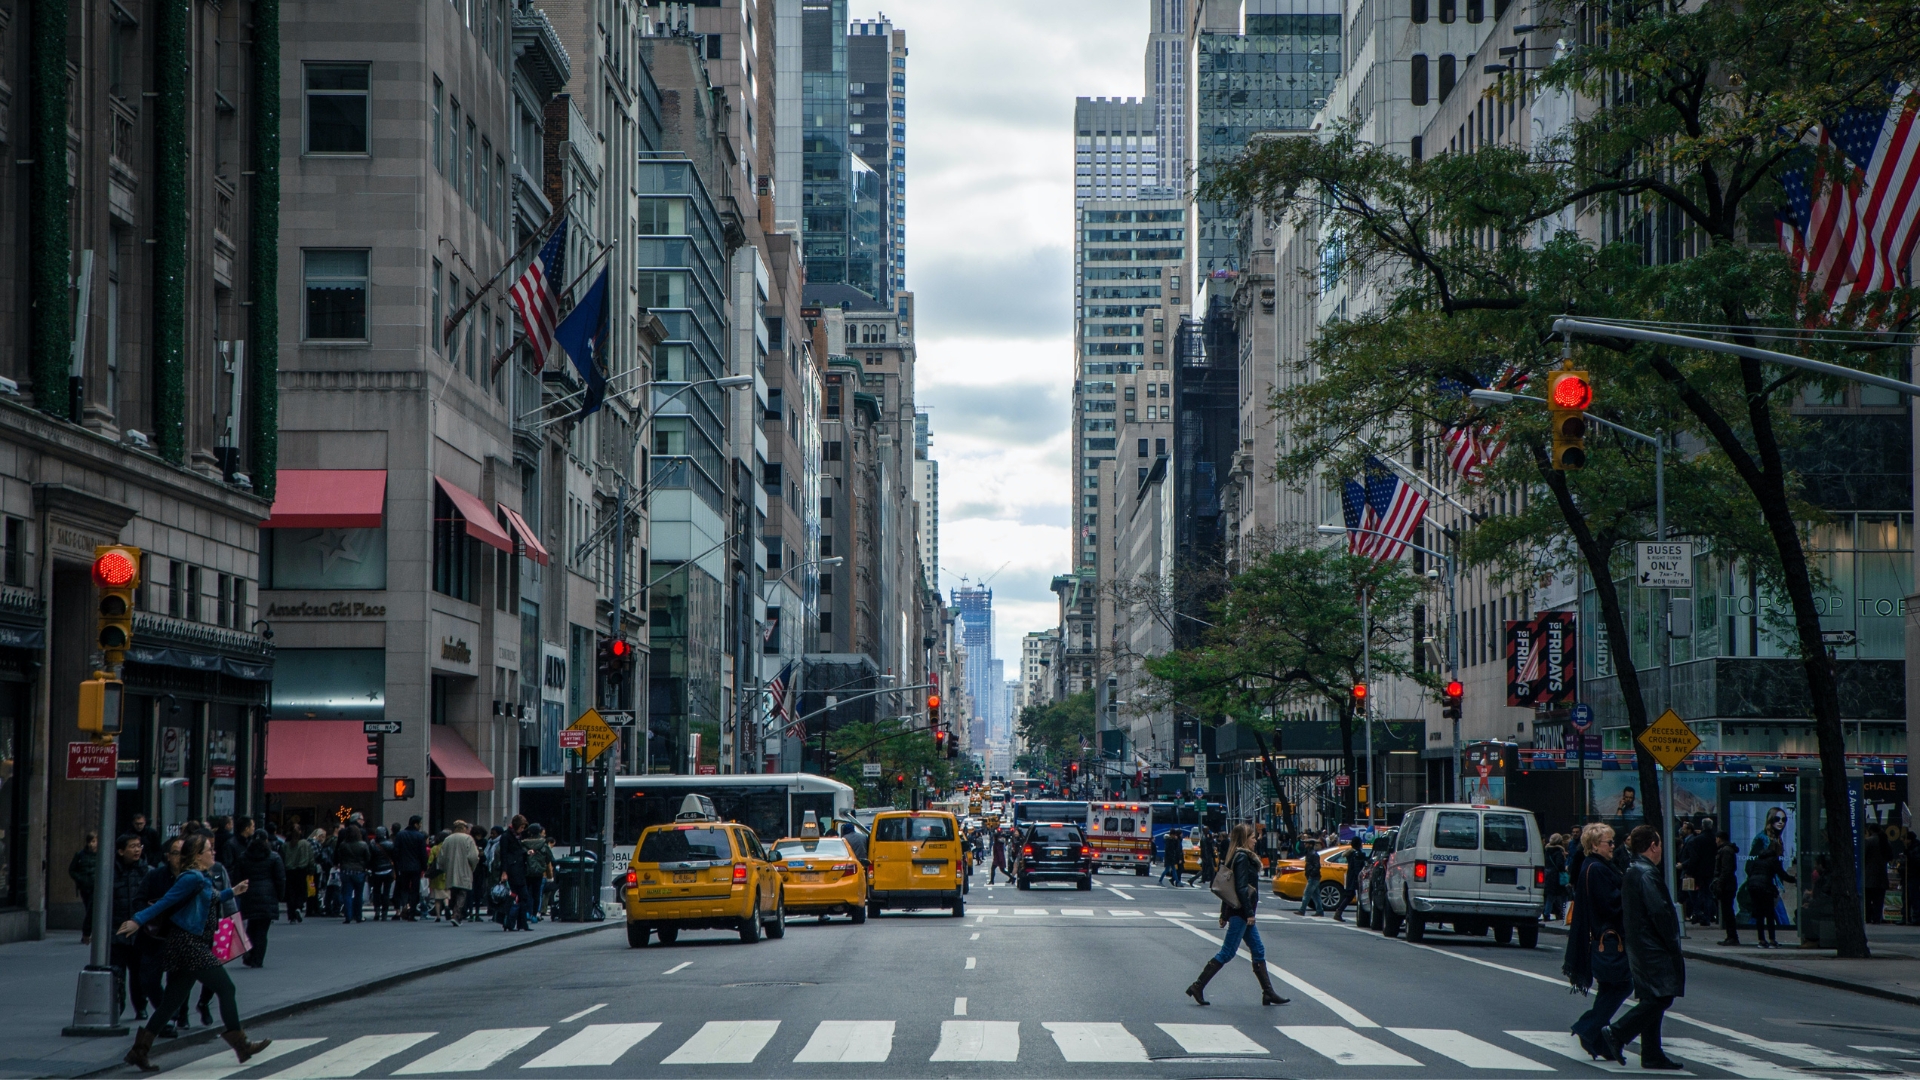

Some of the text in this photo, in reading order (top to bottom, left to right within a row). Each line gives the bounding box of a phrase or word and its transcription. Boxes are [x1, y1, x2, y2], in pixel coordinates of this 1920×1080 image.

[1647, 545, 1682, 555] BUSES
[1650, 561, 1678, 570] ONLY
[266, 602, 386, 617] American Girl Place
[1720, 595, 1844, 616] TOPSOP
[1548, 622, 1562, 630] TGI
[1517, 630, 1530, 638] TGI
[1548, 630, 1562, 692] FRIDAYS
[1517, 638, 1530, 696] FRIDYS
[544, 654, 567, 690] ALDO
[574, 724, 608, 732] RECESSED
[1651, 728, 1689, 736] RECESSED
[1648, 736, 1692, 745] CROSSWALK
[71, 745, 115, 754] NO STOPPING
[75, 756, 109, 764] ANYTIME
